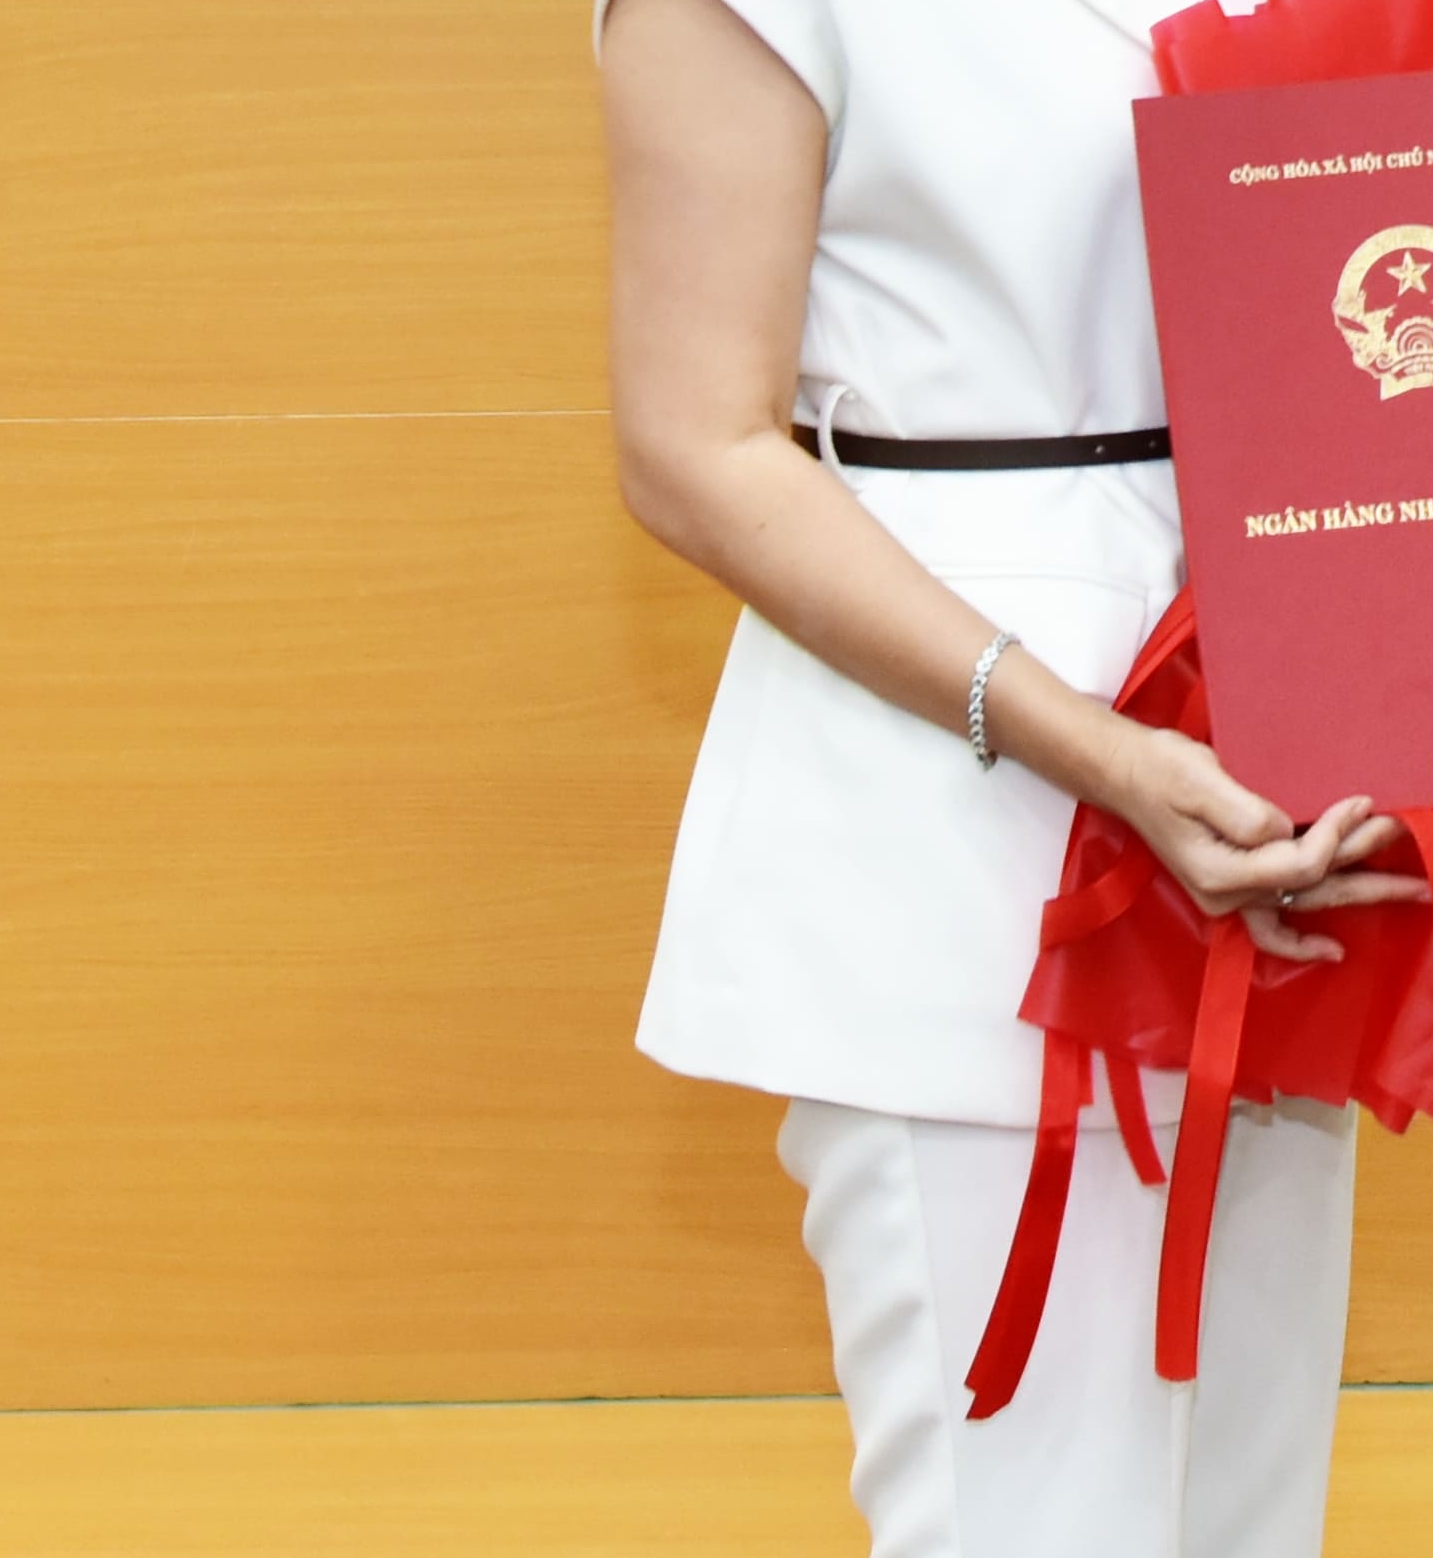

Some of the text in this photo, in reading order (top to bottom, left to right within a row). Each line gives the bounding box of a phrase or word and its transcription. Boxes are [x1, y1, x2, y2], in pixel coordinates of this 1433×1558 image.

[1229, 163, 1280, 186] CỘNG
[1349, 151, 1383, 174] HỘI
[1244, 505, 1318, 538] NGÂN
[1322, 500, 1395, 531] HÀNG
